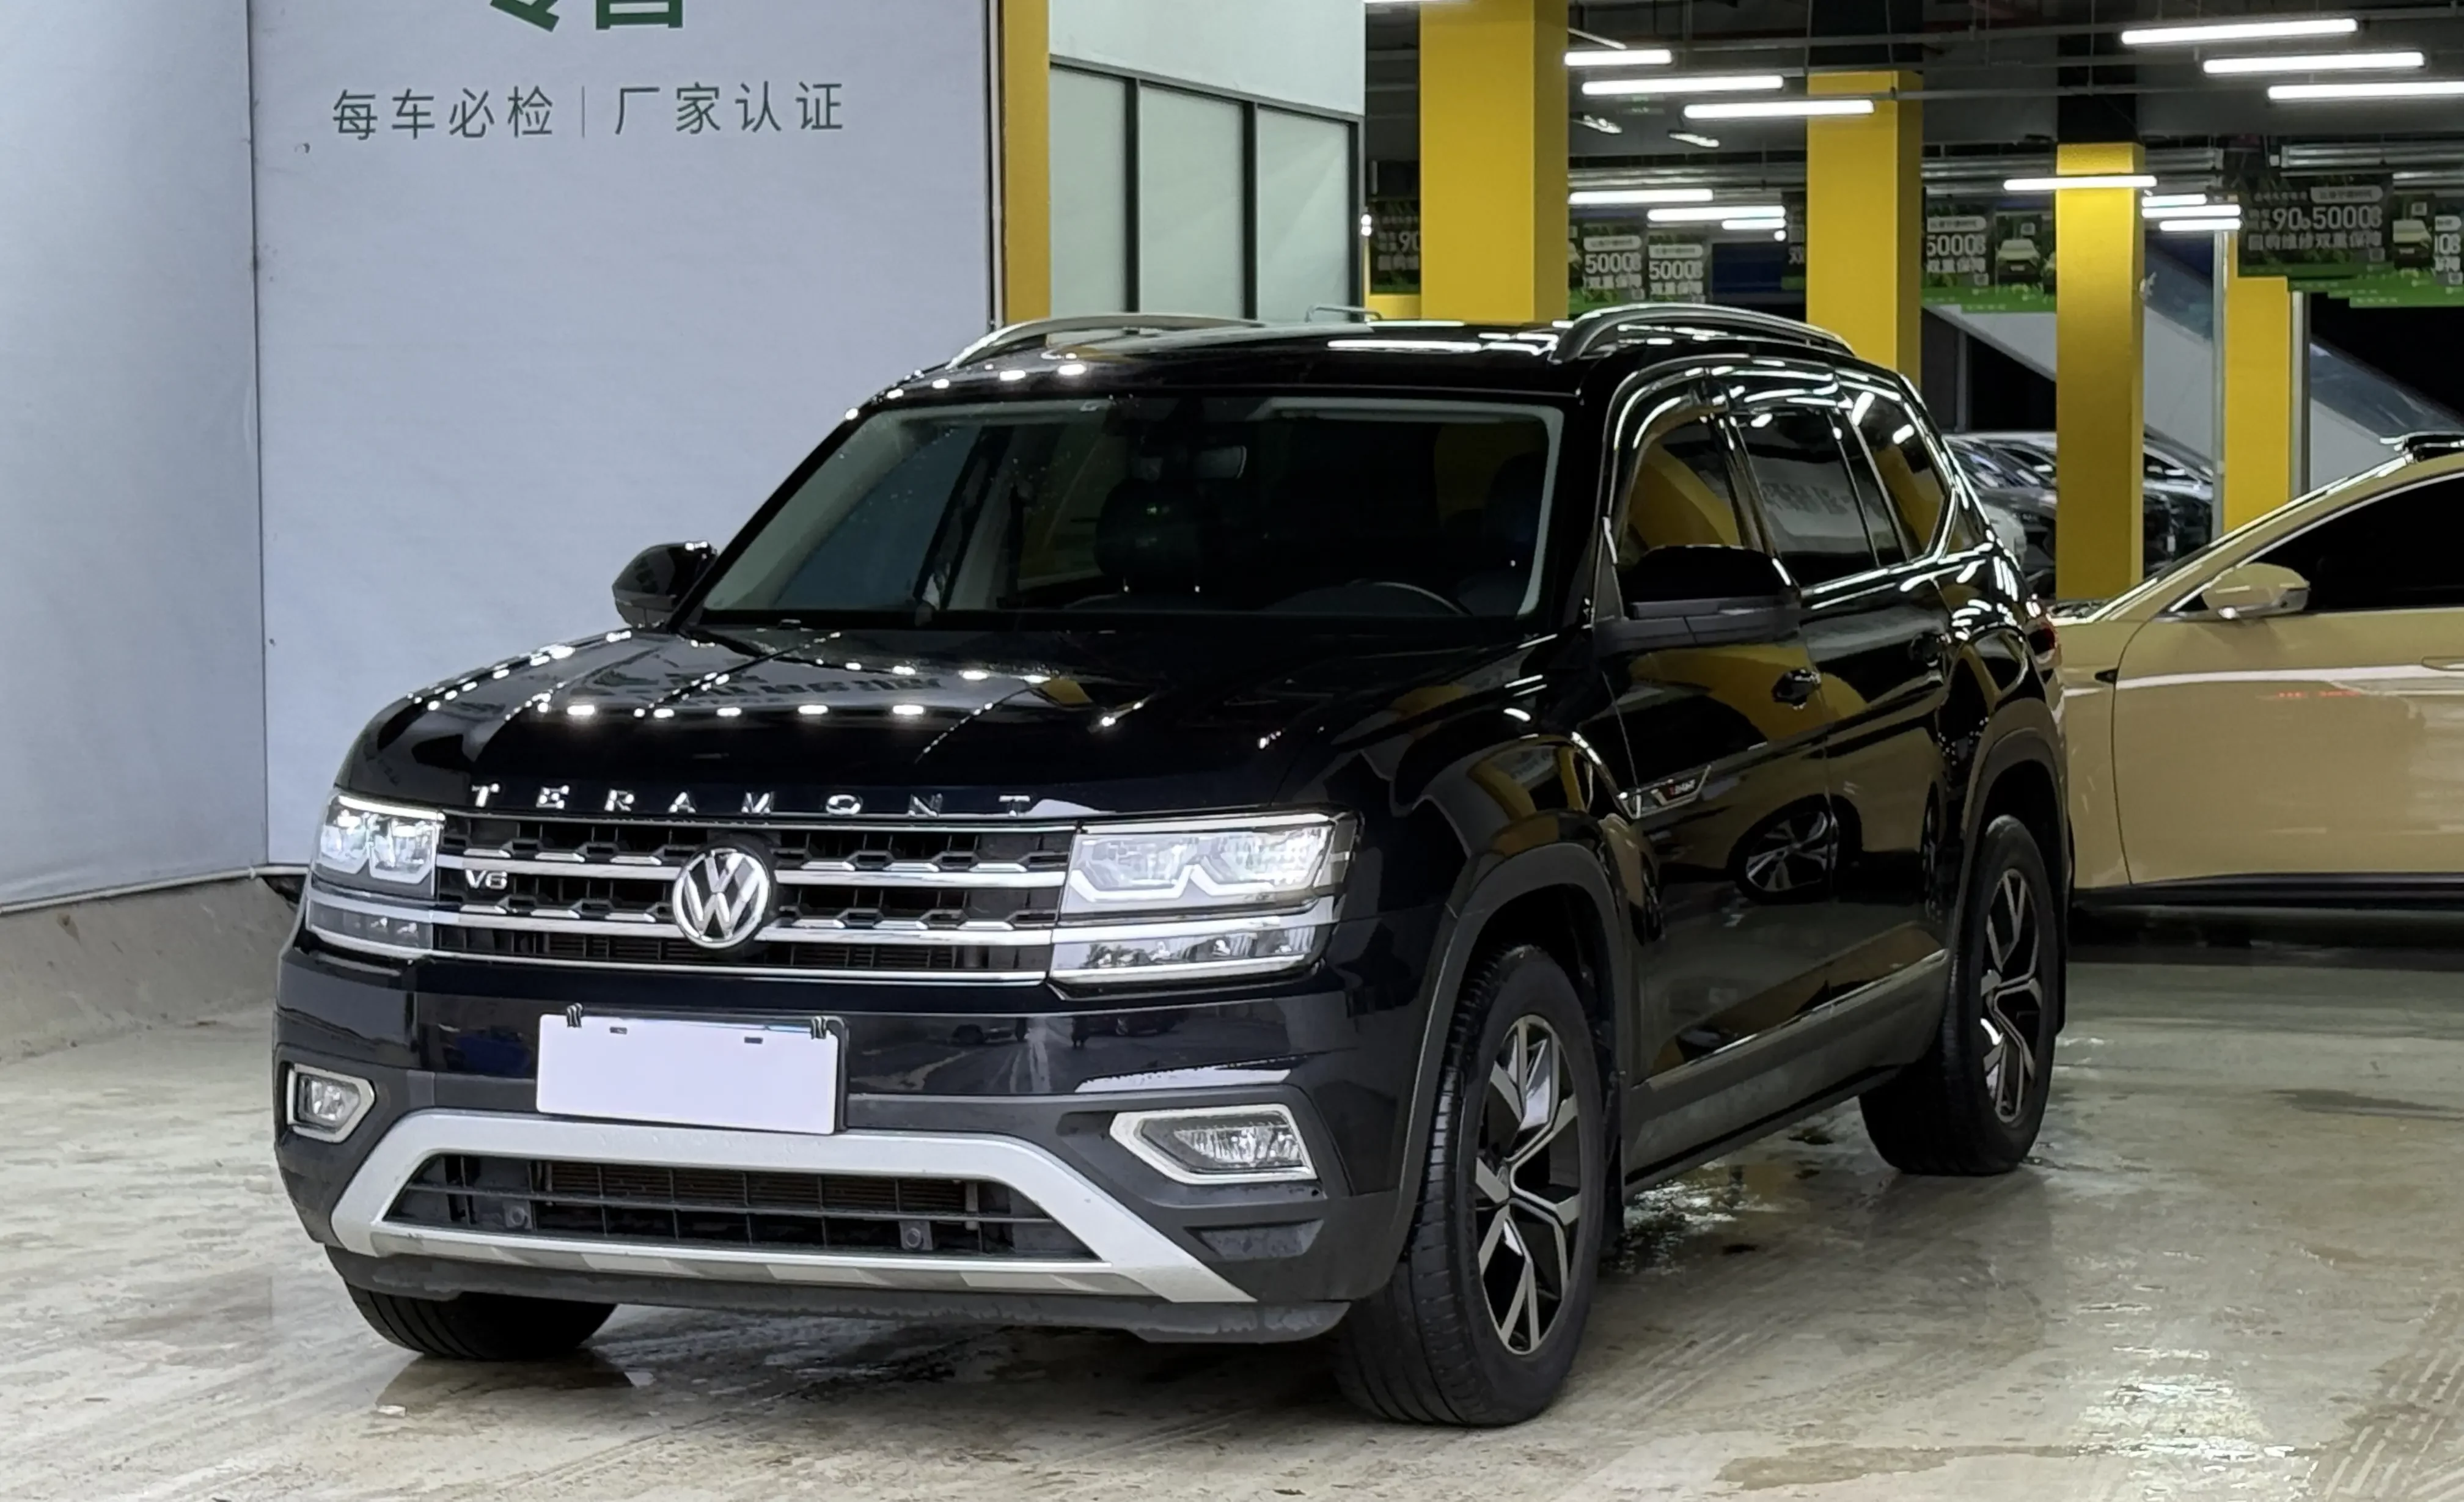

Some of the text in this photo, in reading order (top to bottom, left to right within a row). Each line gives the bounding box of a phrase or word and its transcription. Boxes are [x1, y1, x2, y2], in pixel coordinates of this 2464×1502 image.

[333, 81, 842, 140] 每车必检 厂家认证
[471, 783, 1031, 818] TERAMONT
[466, 869, 508, 890] V6
